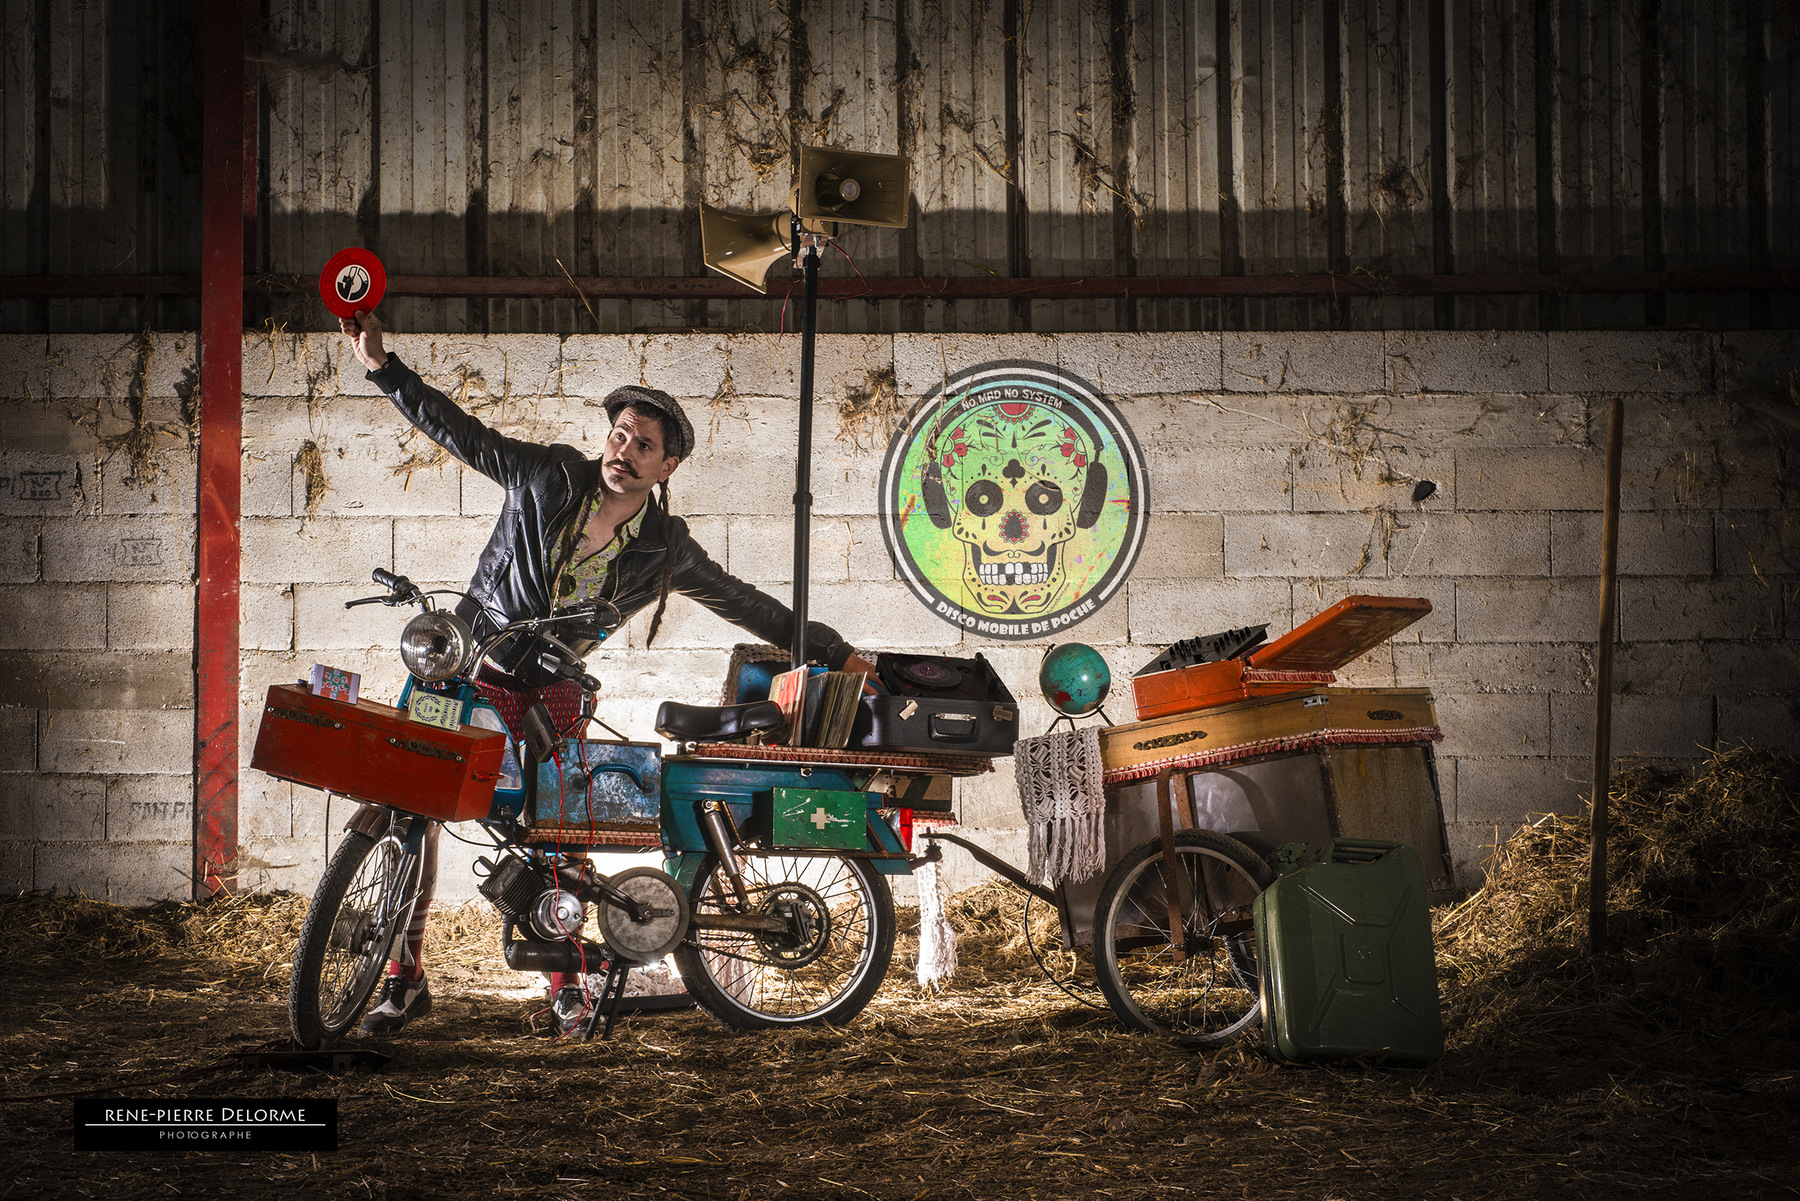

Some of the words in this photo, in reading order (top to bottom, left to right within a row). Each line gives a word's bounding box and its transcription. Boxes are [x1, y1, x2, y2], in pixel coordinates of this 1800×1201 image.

[961, 398, 976, 411] NO
[1004, 388, 1019, 398] NO
[1022, 388, 1063, 409] SYSTEM
[935, 600, 976, 628] DISCO
[977, 619, 1030, 635] MOBILE
[1031, 620, 1051, 634] DE
[1050, 598, 1096, 629] POCHE
